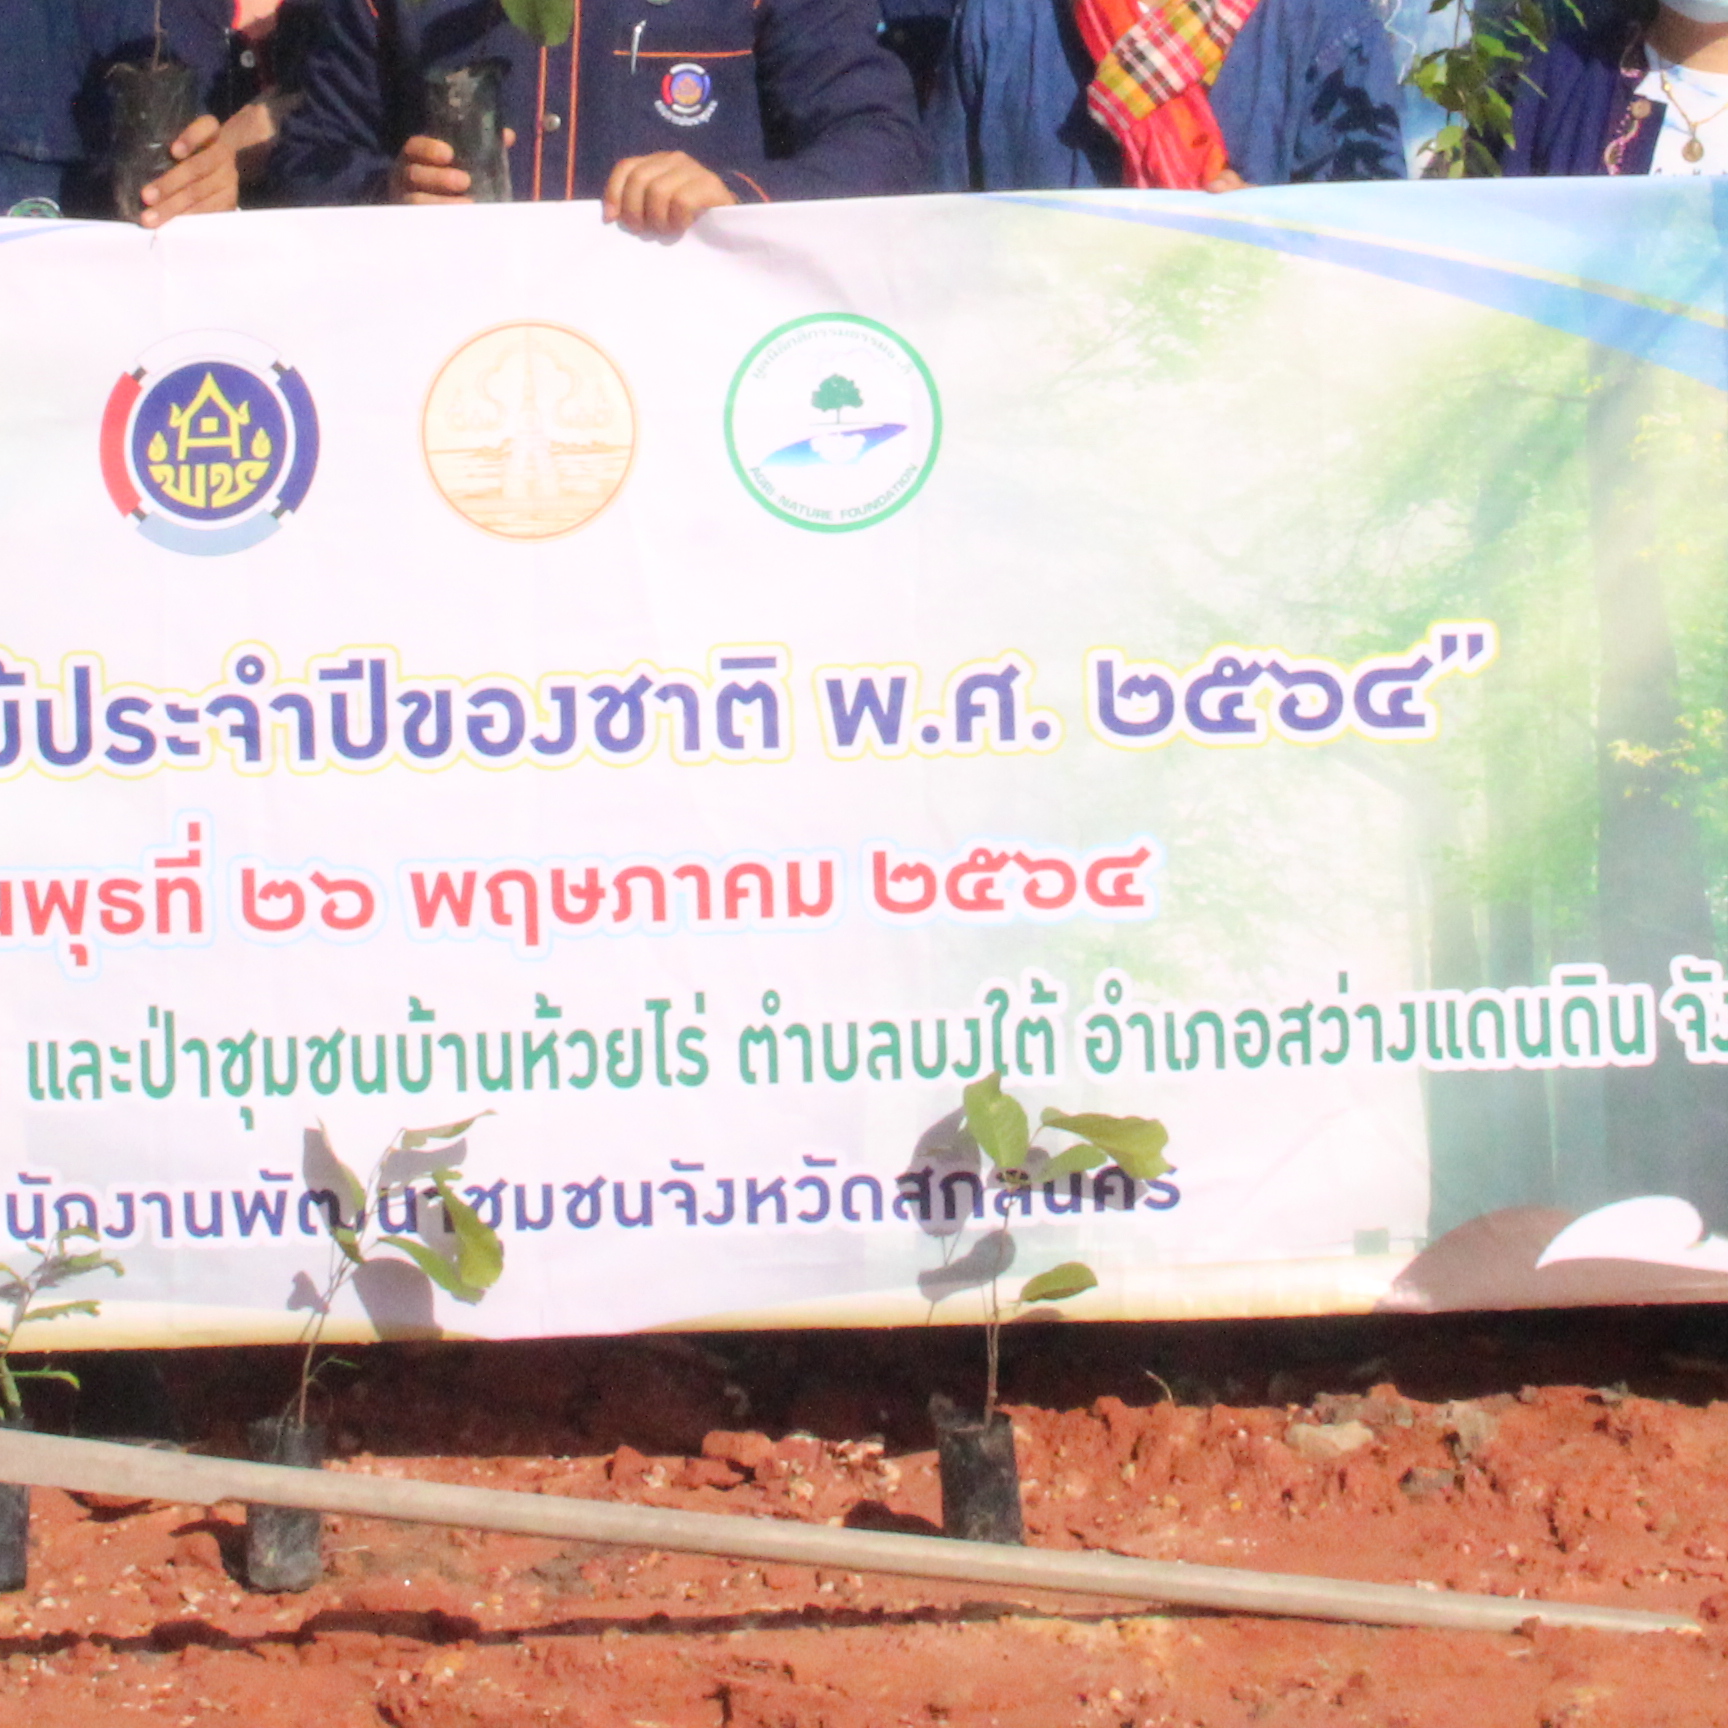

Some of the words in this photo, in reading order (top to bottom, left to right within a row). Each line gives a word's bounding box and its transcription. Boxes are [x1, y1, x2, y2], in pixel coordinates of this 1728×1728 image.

[778, 494, 833, 521] NATURE
[839, 462, 919, 521] FOUNDATION
[825, 663, 1052, 747] พ.ศ.
[240, 867, 376, 931] ๒๖
[409, 859, 834, 947] พฤษภาคม
[873, 845, 1152, 914] ๒๕๖๔
[27, 991, 709, 1132] และป่าชุมชนบ้านห้วยไร่
[738, 978, 1057, 1085] ตำบลบงใต้
[1084, 970, 1647, 1074] อำเภอสว่างแดนดิน
